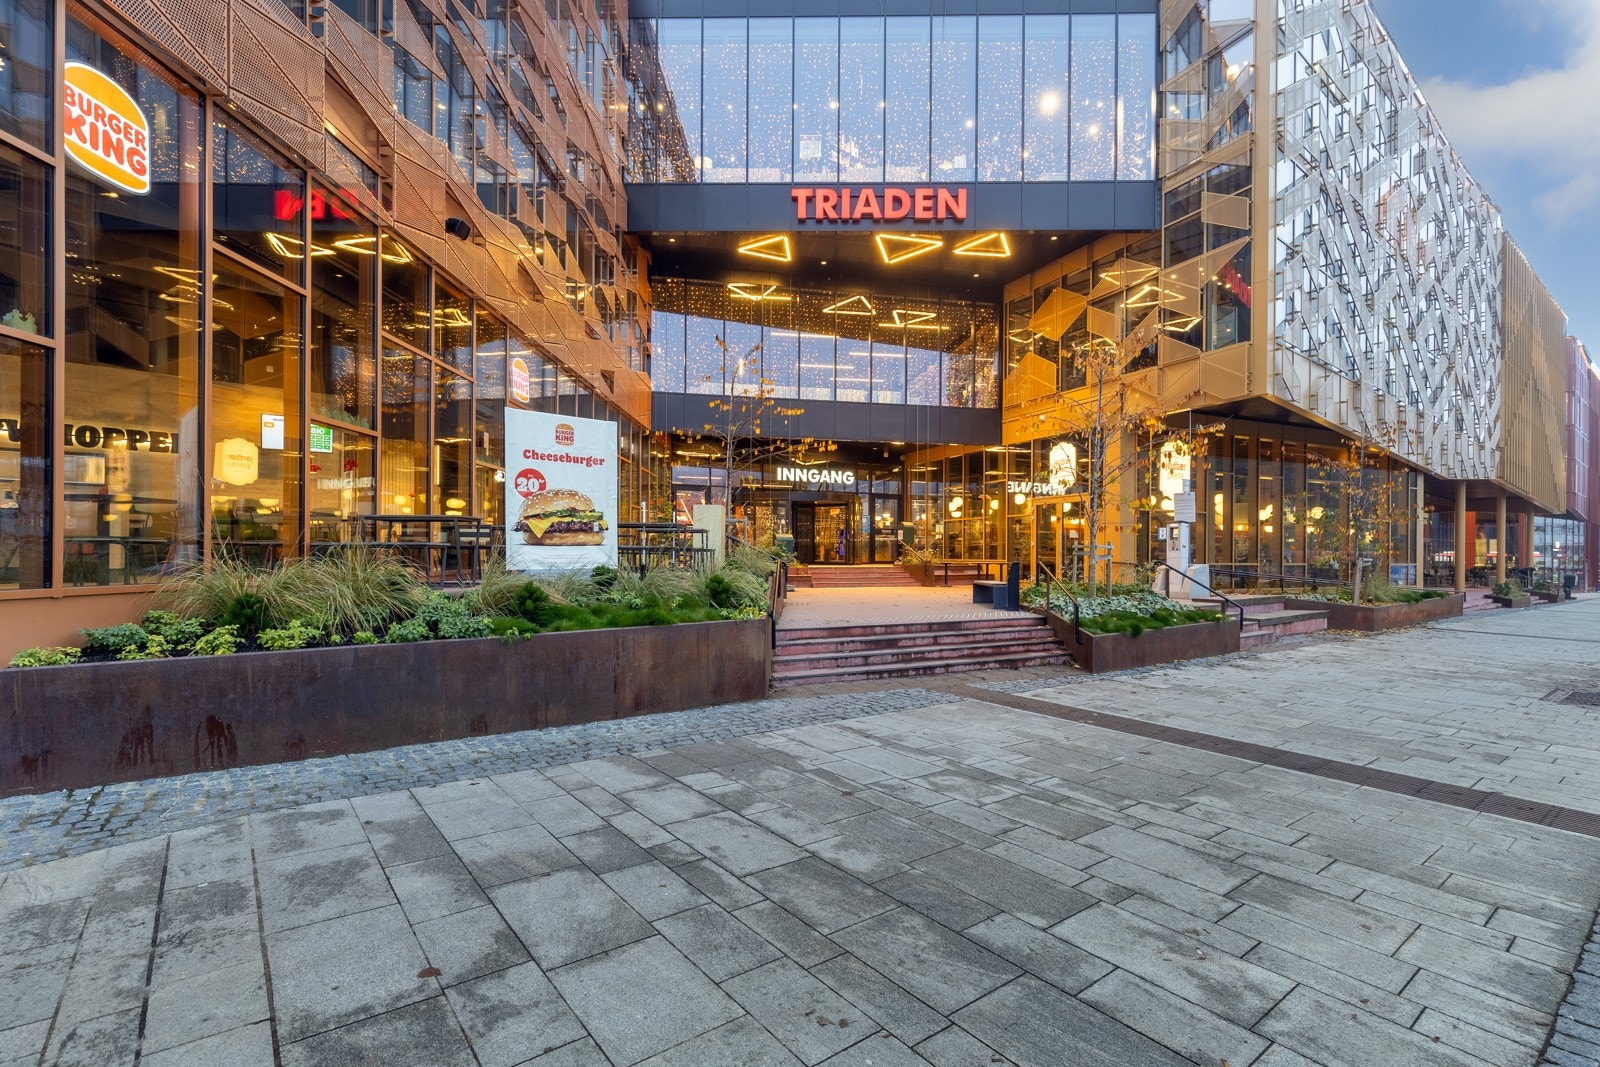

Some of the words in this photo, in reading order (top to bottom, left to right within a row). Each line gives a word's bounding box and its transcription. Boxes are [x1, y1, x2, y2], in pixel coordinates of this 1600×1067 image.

[64, 83, 147, 152] BURGER
[64, 105, 147, 177] KING
[790, 188, 967, 220] TRIADEN
[555, 434, 575, 443] KING
[523, 449, 605, 467] Cheeseburger
[516, 477, 540, 493] 20
[776, 467, 855, 485] INNGANG
